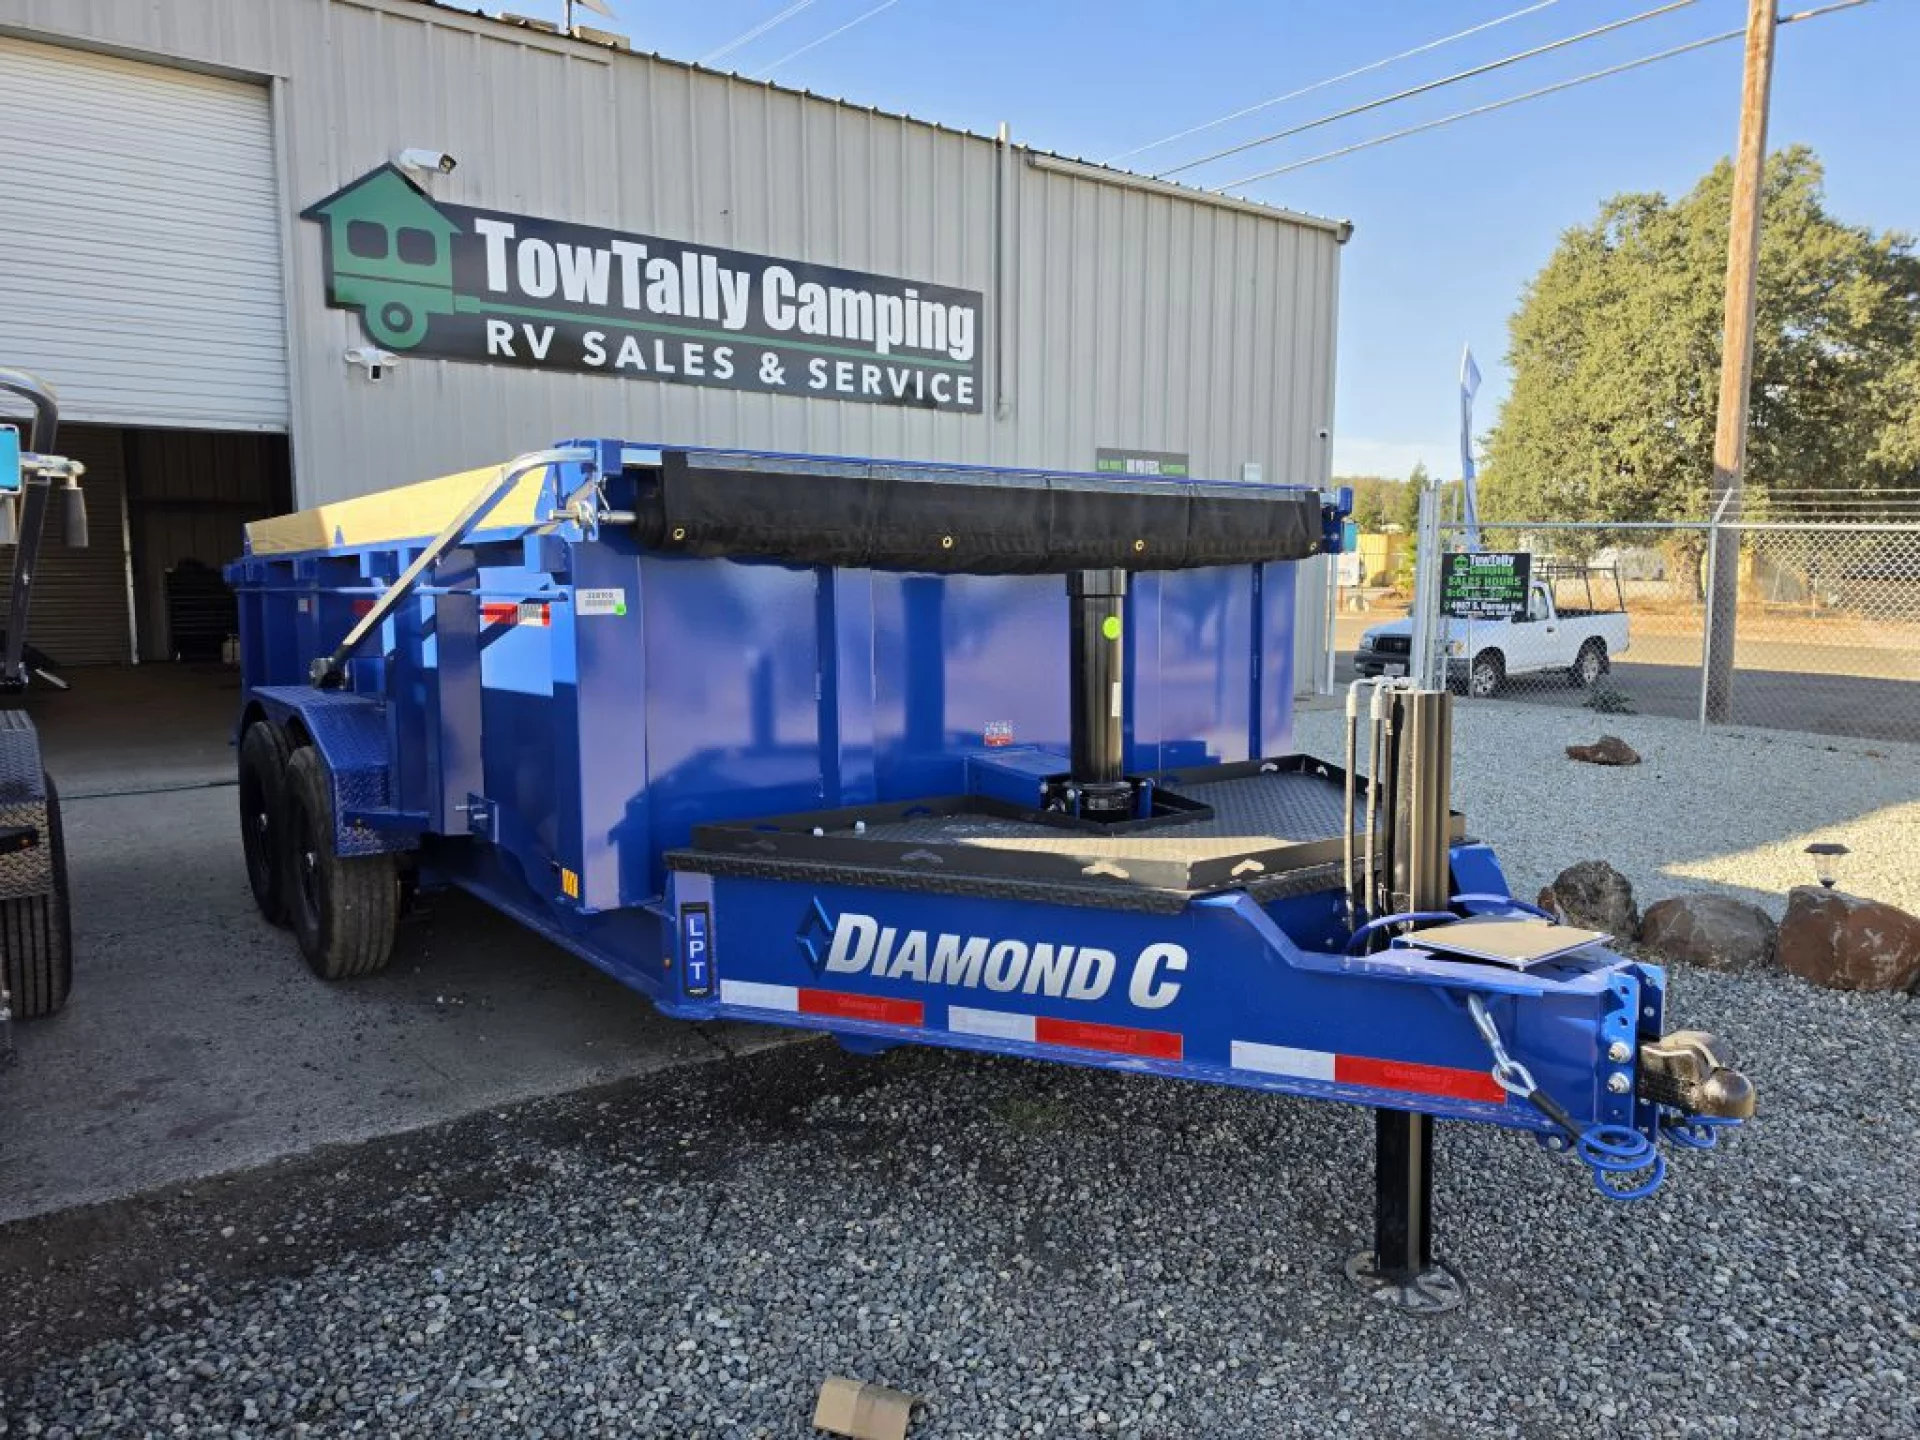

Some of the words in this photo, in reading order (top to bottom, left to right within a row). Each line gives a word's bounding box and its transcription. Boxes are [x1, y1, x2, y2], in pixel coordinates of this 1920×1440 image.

[474, 217, 750, 330] TowTally
[762, 265, 974, 361] Camping
[486, 319, 556, 360] RV
[582, 331, 735, 379] SALES
[758, 352, 786, 385] &
[807, 357, 974, 404] SERVICE
[1484, 575, 1522, 586] HOURS
[689, 918, 706, 980] LPT
[826, 912, 1117, 1000] DIAMOND
[1128, 942, 1188, 1009] C
